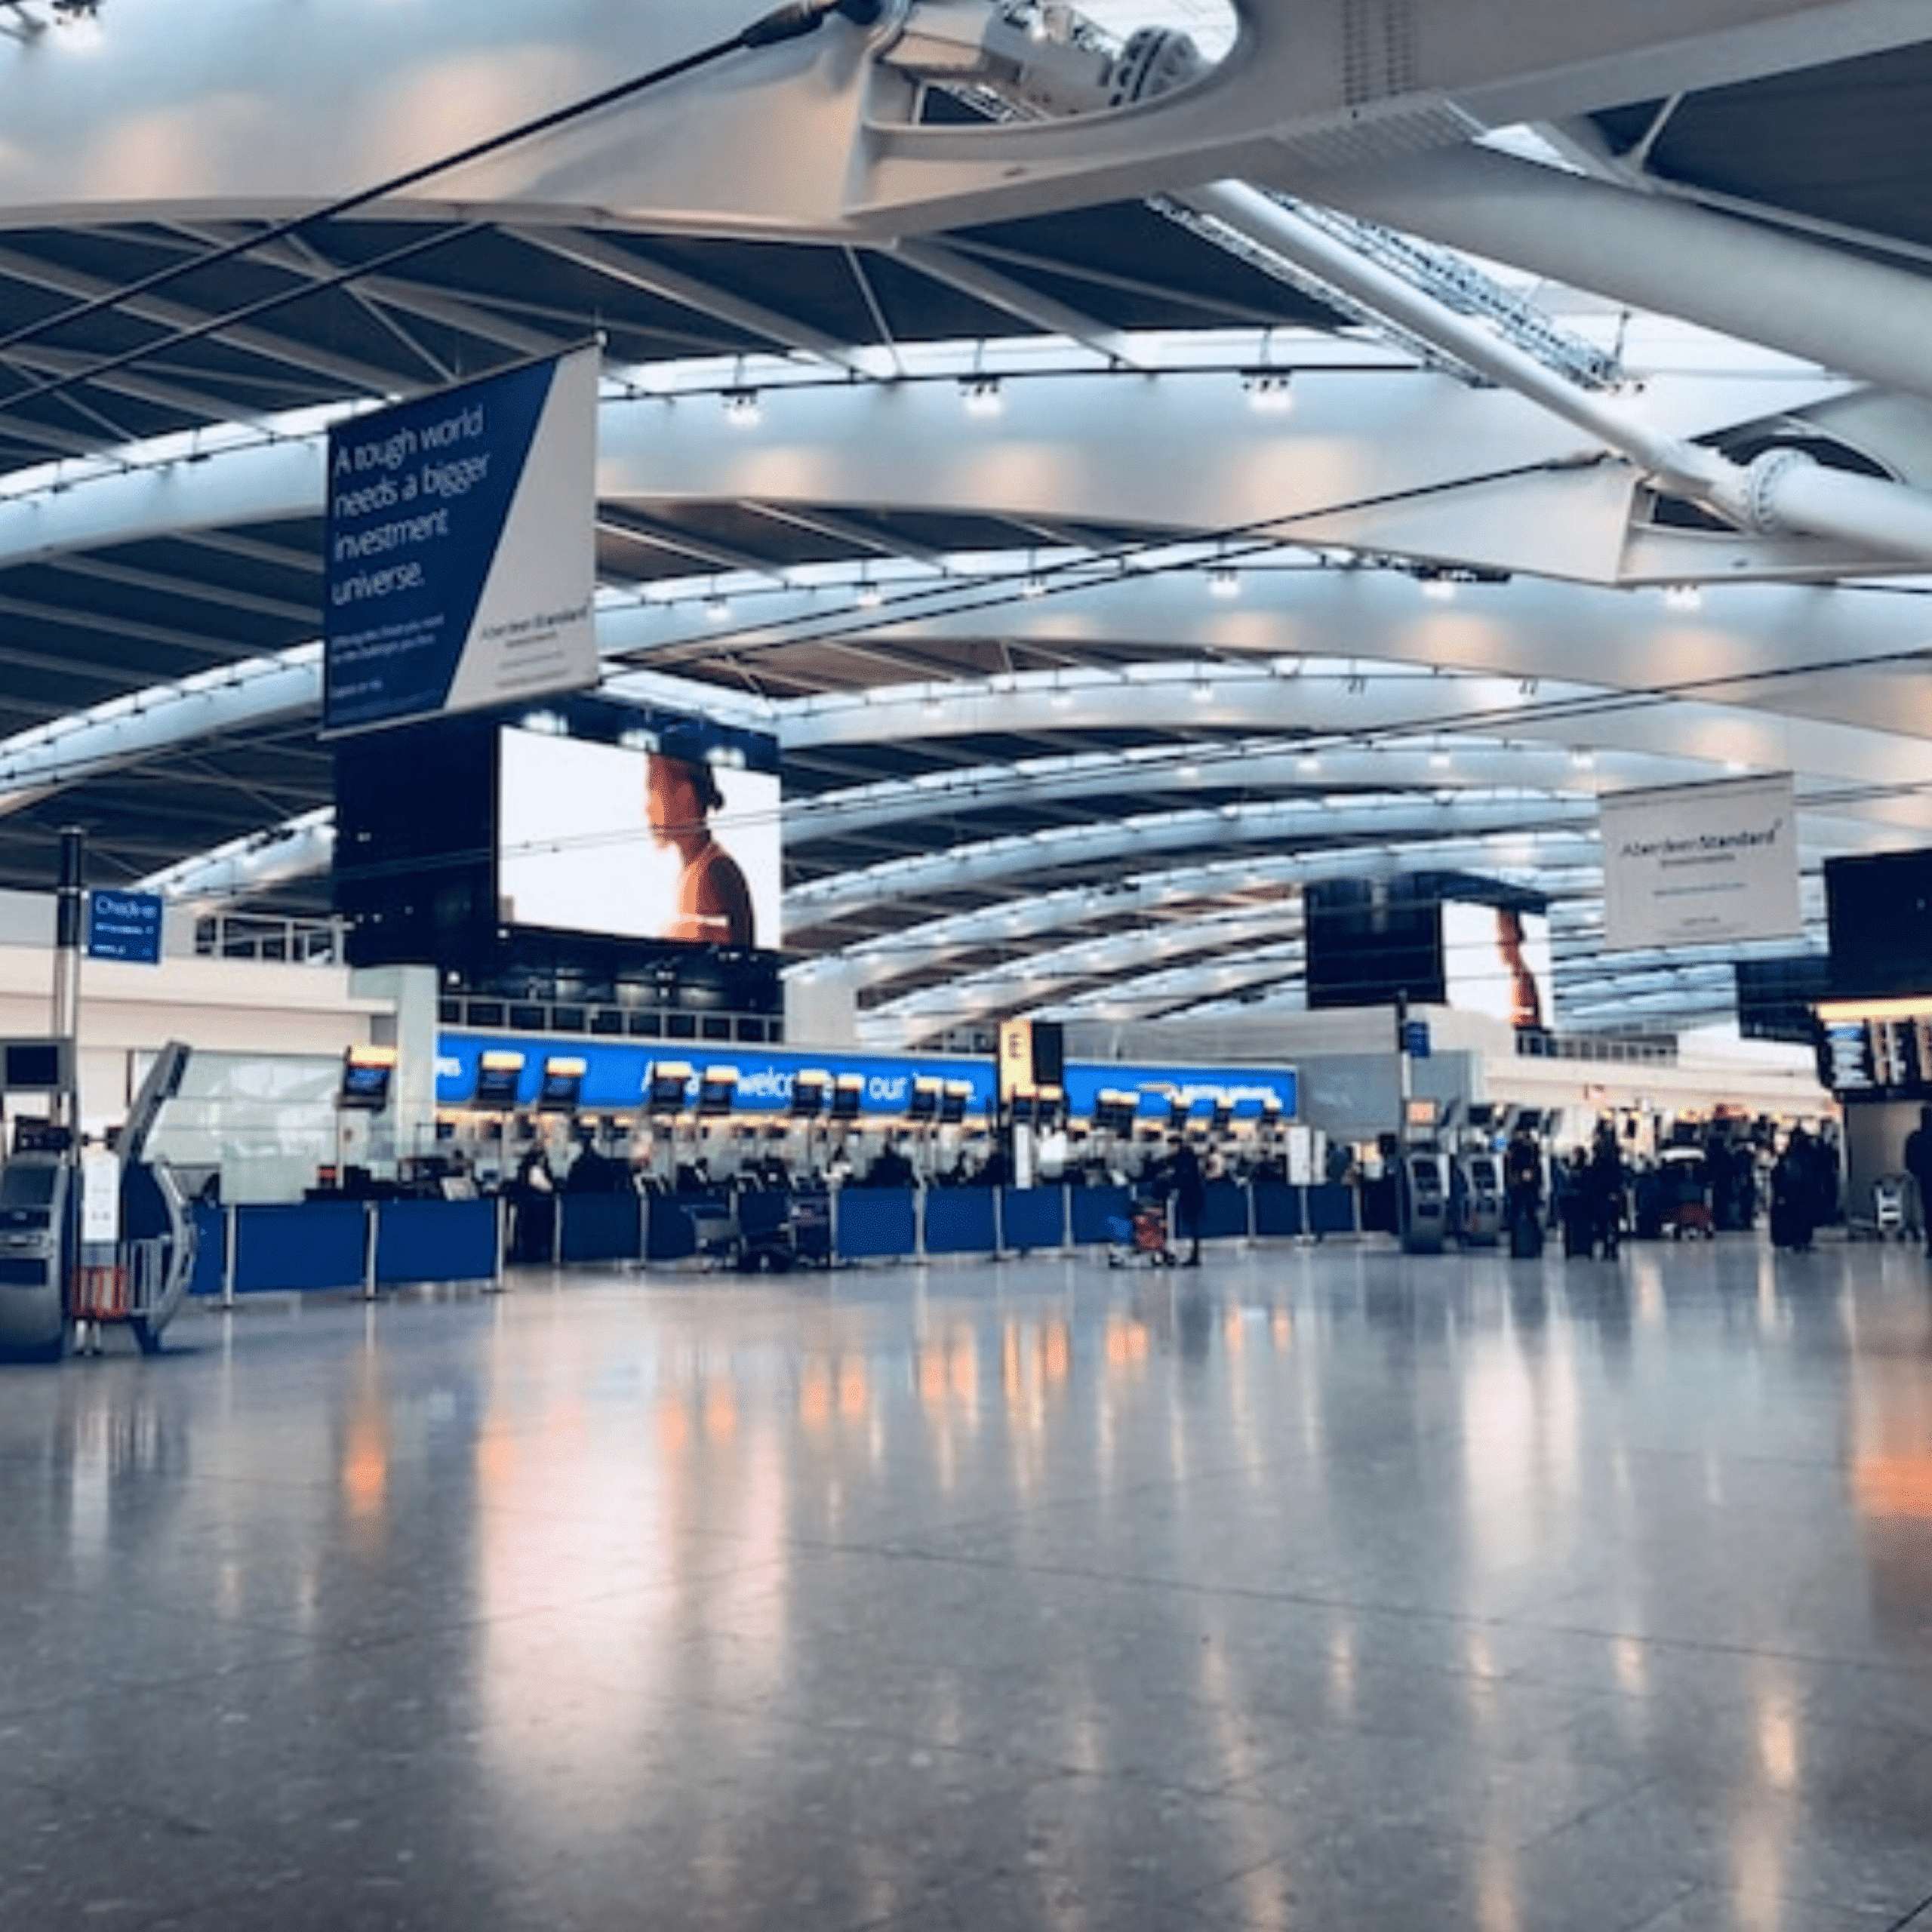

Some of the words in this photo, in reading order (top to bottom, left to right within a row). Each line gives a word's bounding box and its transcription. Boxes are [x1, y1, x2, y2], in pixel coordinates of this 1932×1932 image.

[335, 445, 352, 477] A
[354, 427, 418, 471] tough
[420, 403, 485, 451] world
[335, 477, 399, 518] needs
[401, 472, 418, 501] a
[422, 453, 491, 498] bigger
[334, 508, 450, 561] investment
